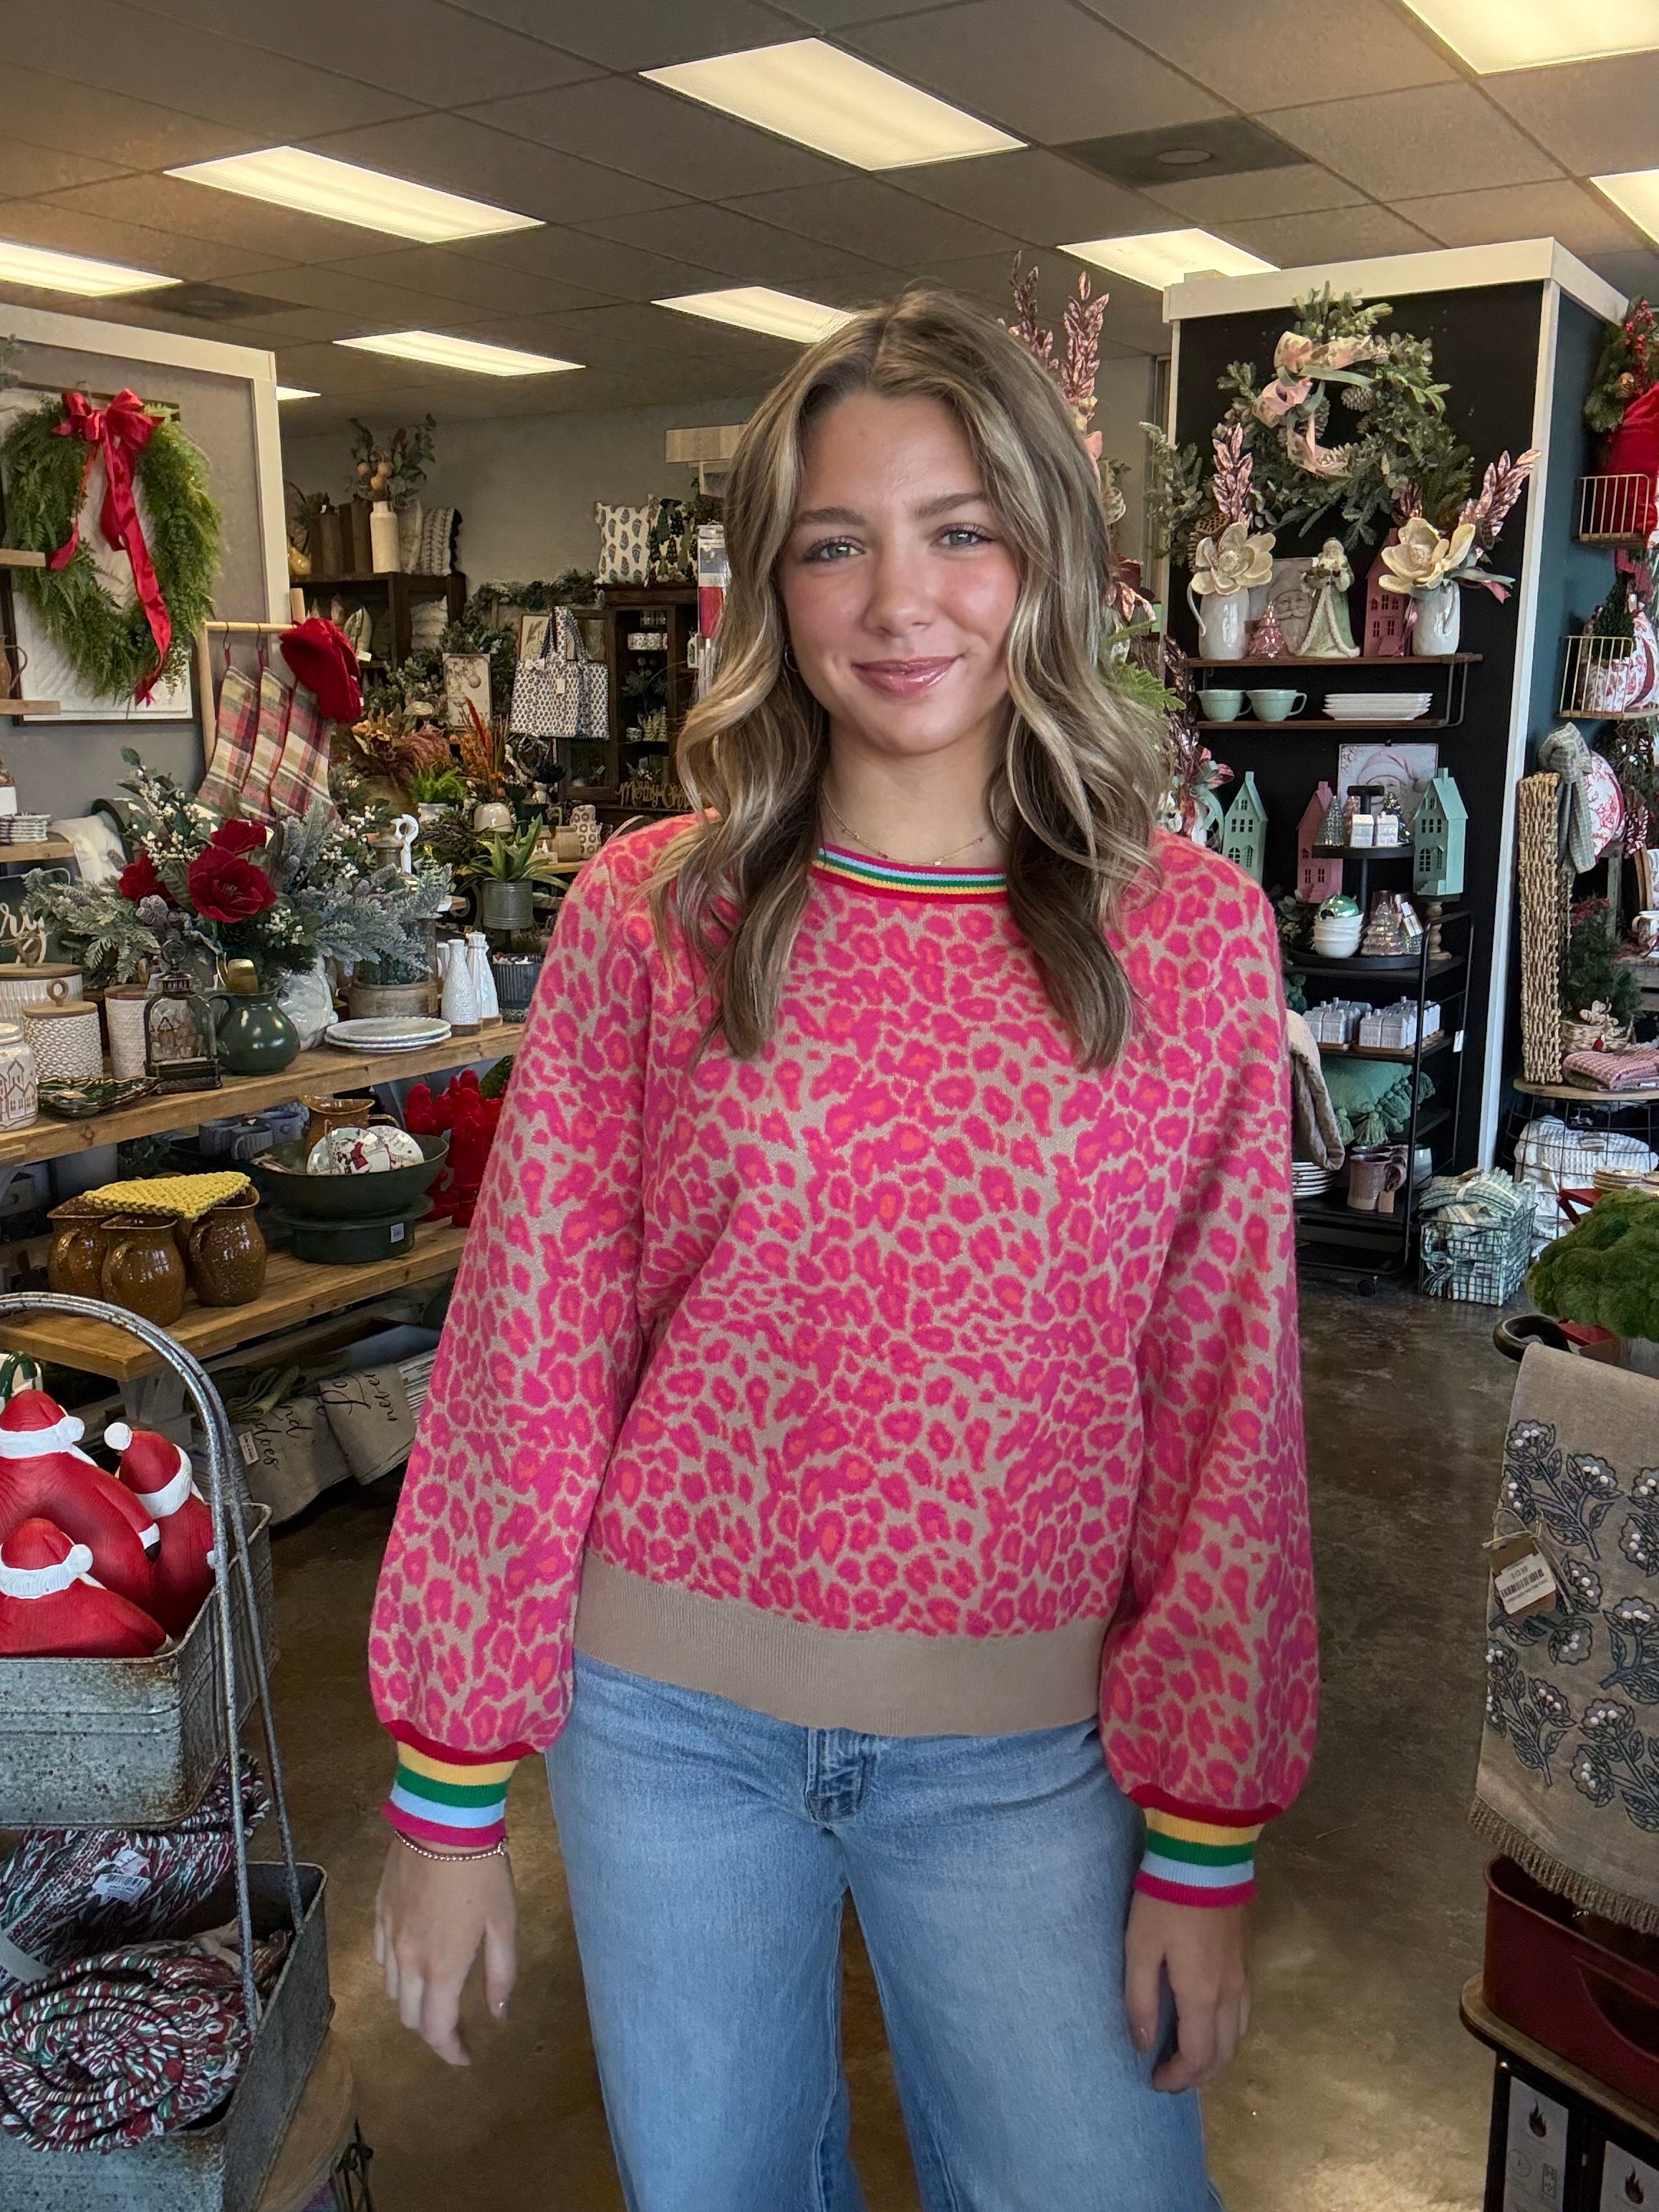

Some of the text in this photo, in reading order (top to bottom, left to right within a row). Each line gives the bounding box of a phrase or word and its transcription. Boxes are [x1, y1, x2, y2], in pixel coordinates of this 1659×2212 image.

[615, 781, 661, 809] Merry
[0, 903, 47, 964] ry
[254, 1421, 283, 1471] does
